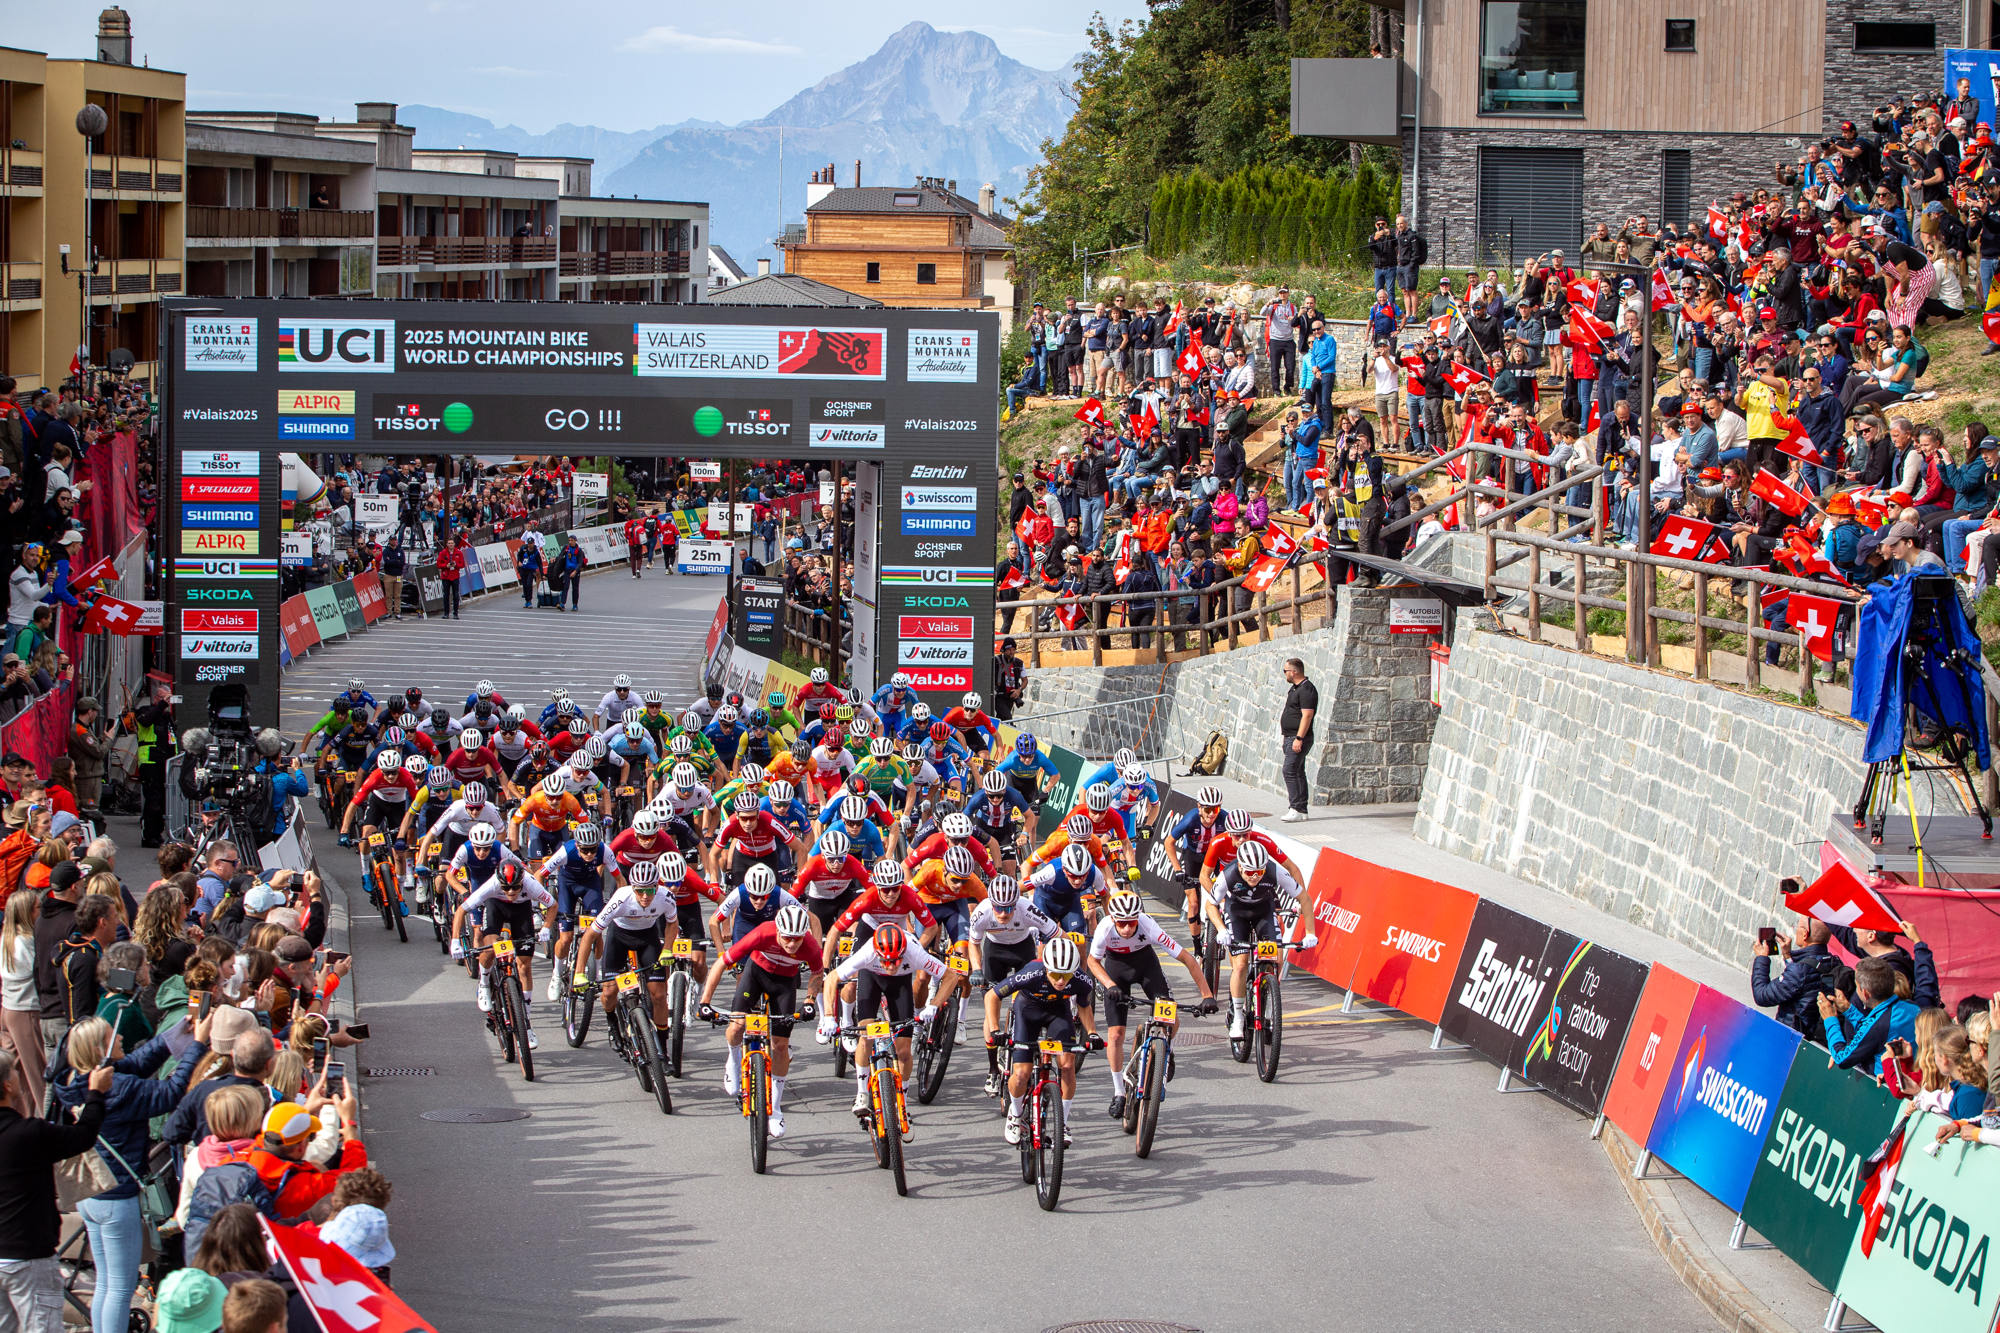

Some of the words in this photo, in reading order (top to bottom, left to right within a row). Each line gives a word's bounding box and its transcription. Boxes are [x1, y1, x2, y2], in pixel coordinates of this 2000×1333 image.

[192, 325, 231, 334] CRANS
[193, 336, 250, 345] MONTANA
[404, 330, 444, 344] 2025
[448, 330, 545, 345] MOUNTAIN
[550, 331, 589, 346] BIKE
[647, 332, 706, 347] VALAIS
[914, 336, 953, 346] CRANS
[299, 328, 385, 363] UCI
[195, 347, 246, 363] Absolutely
[914, 347, 971, 357] MONTANA
[404, 349, 470, 365] WORLD
[474, 350, 624, 367] CHAMPIONSHIPS
[647, 353, 769, 370] SWITZERLAND
[916, 358, 967, 375] Absolutely
[293, 395, 341, 411] ALPIQ
[826, 400, 872, 410] OCHSNER
[183, 408, 258, 420] #Valais2025
[823, 409, 855, 417] SPORT
[375, 417, 441, 430] TISSOT
[545, 408, 589, 431] GO
[598, 409, 622, 431] !!!
[904, 418, 977, 431] #Valais2025
[283, 423, 349, 434] SHIMANO
[726, 422, 791, 435] TISSOT
[831, 429, 878, 442] vittoria
[200, 461, 241, 469] TISSOT
[694, 468, 715, 476] 100m
[910, 465, 968, 478] Santini
[579, 479, 599, 488] 75m
[197, 486, 252, 494] SPECIALIZED
[918, 492, 973, 503] swisscom
[363, 502, 388, 511] 50m
[187, 511, 253, 520] SHIMANO
[906, 519, 971, 529] SHIMANO
[196, 534, 245, 550] ALPIQ
[917, 542, 963, 551] OCHSNER
[691, 550, 721, 561] 25m
[914, 550, 946, 558] SPORT
[205, 562, 236, 574] UCI
[687, 565, 725, 573] SHIMANO
[922, 570, 953, 582] UCI
[744, 597, 780, 609] START
[212, 614, 244, 625] Valais
[928, 621, 959, 632] Valais
[203, 640, 253, 653] vittoria
[920, 647, 968, 659] vittoria
[198, 665, 245, 673] OCHSNER
[196, 673, 228, 681] SPORT
[905, 673, 966, 685] ValJob
[1316, 901, 1361, 934] SPECIALIZED
[500, 943, 507, 951] 8
[677, 943, 688, 952] 13
[1261, 945, 1275, 954] 20
[1381, 925, 1446, 963] S-WORKS
[624, 977, 631, 985] 6
[1580, 965, 1600, 998] the
[1458, 938, 1553, 1037] Santini
[1160, 1006, 1172, 1016] 16
[753, 1019, 761, 1029] 4
[1567, 1001, 1610, 1041] rainbow
[875, 1025, 882, 1034] 2
[1640, 1032, 1662, 1071] RTS
[1556, 1034, 1592, 1082] factory
[1696, 1062, 1768, 1136] swisscom
